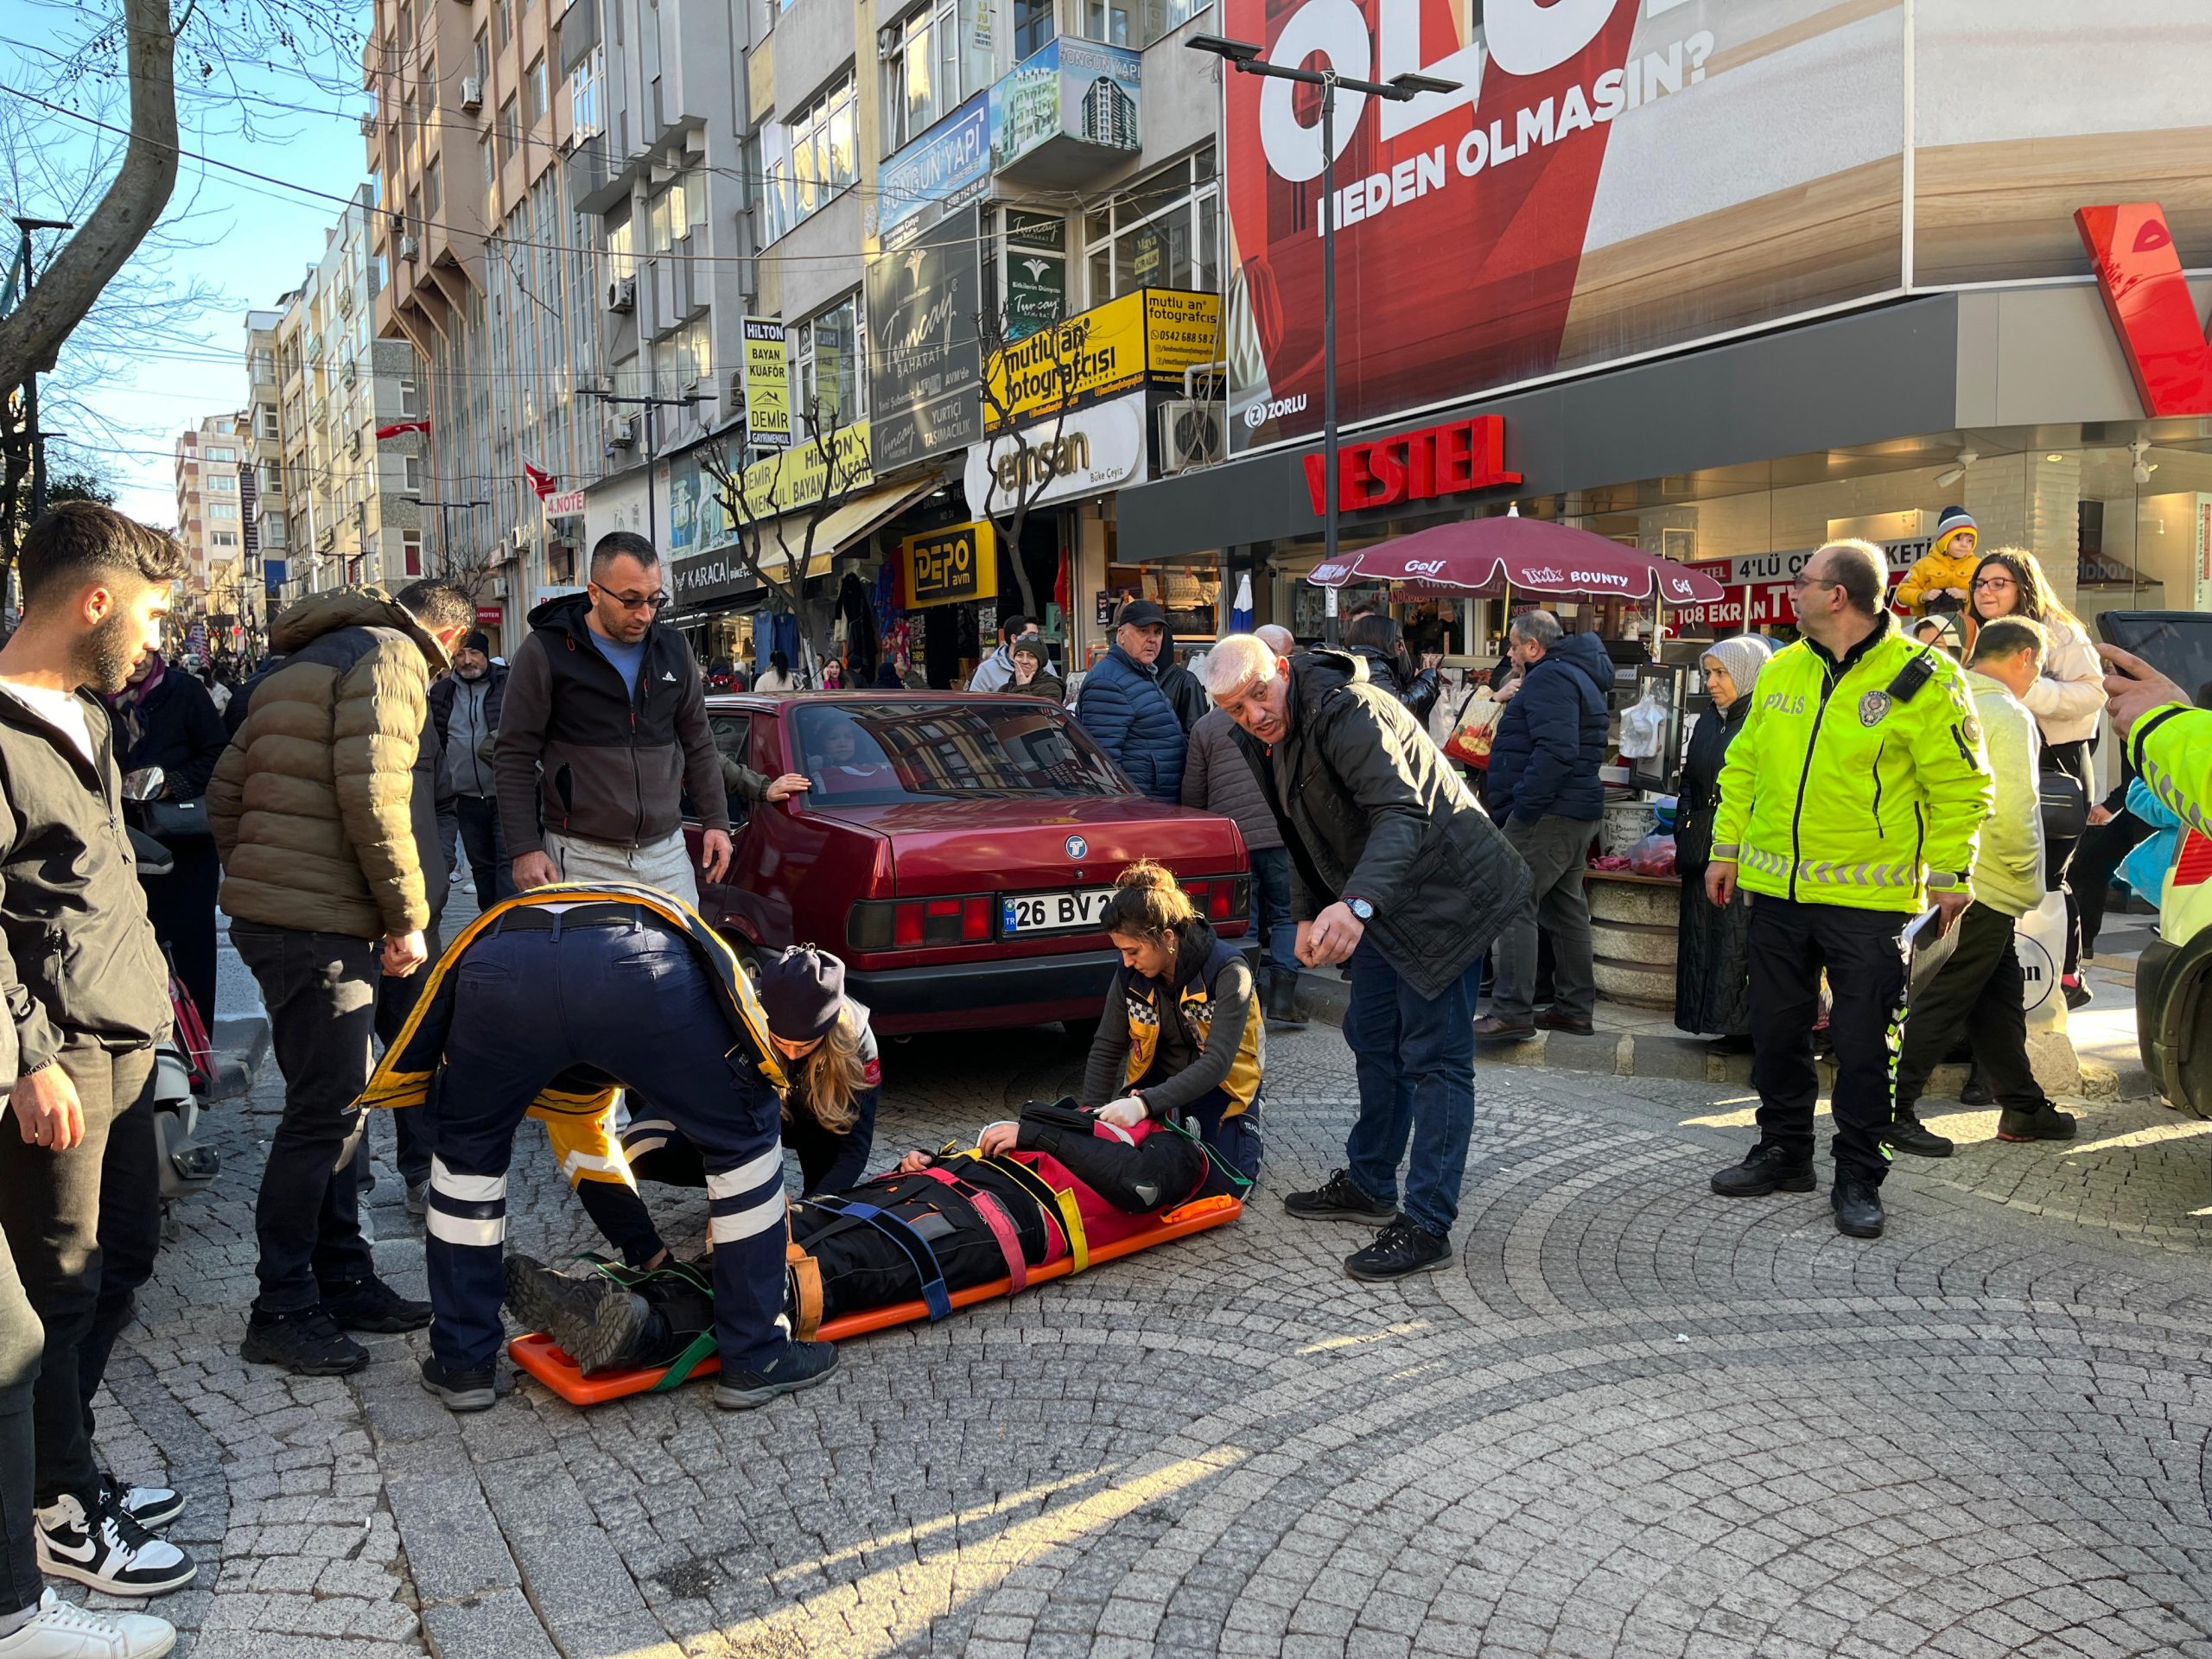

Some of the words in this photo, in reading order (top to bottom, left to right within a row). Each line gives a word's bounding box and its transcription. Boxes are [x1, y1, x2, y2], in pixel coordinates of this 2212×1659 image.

[1113, 59, 1141, 79] YAPI
[1318, 145, 1446, 238] NEDEN
[1456, 30, 1714, 178] OLMASIN?
[944, 124, 980, 175] YAPI
[1149, 296, 1183, 309] mutlu
[1188, 300, 1203, 311] an
[1149, 307, 1217, 324] fotografcıs
[882, 292, 957, 373] Tuncay
[1160, 330, 1179, 341] 0542
[1181, 332, 1197, 343] 688
[1198, 334, 1208, 344] 58
[752, 347, 780, 361] BAYAN
[1006, 334, 1053, 374] mutlu
[1060, 326, 1084, 353] an
[750, 363, 785, 378] KUAFÖR
[897, 346, 941, 378] BAHARAT
[944, 366, 969, 386] AVM'de
[931, 397, 962, 424] YURTİÇİ
[1268, 394, 1307, 420] ZORLU
[752, 410, 789, 429] DEMİR
[752, 433, 791, 445] GAYRİMENKUL
[879, 423, 916, 458] Tuncay
[924, 418, 971, 448] TAŞIMACILIK
[1090, 471, 1105, 483] Büke
[1302, 415, 1522, 516] VESTEL
[743, 465, 771, 492] DEMİR
[793, 473, 824, 503] BAYAN
[830, 455, 869, 491] UAFÖR
[548, 493, 586, 515] 4.NOTE
[915, 538, 969, 589] DEPO
[1404, 560, 1447, 575] Golf
[1738, 554, 1780, 579] 4'LÜ
[688, 562, 727, 589] KARACA
[952, 573, 970, 587] avm
[1570, 571, 1629, 588] BOUNTY
[1677, 606, 1705, 625] 108
[1016, 900, 1046, 927] 26
[1058, 896, 1091, 924] BV
